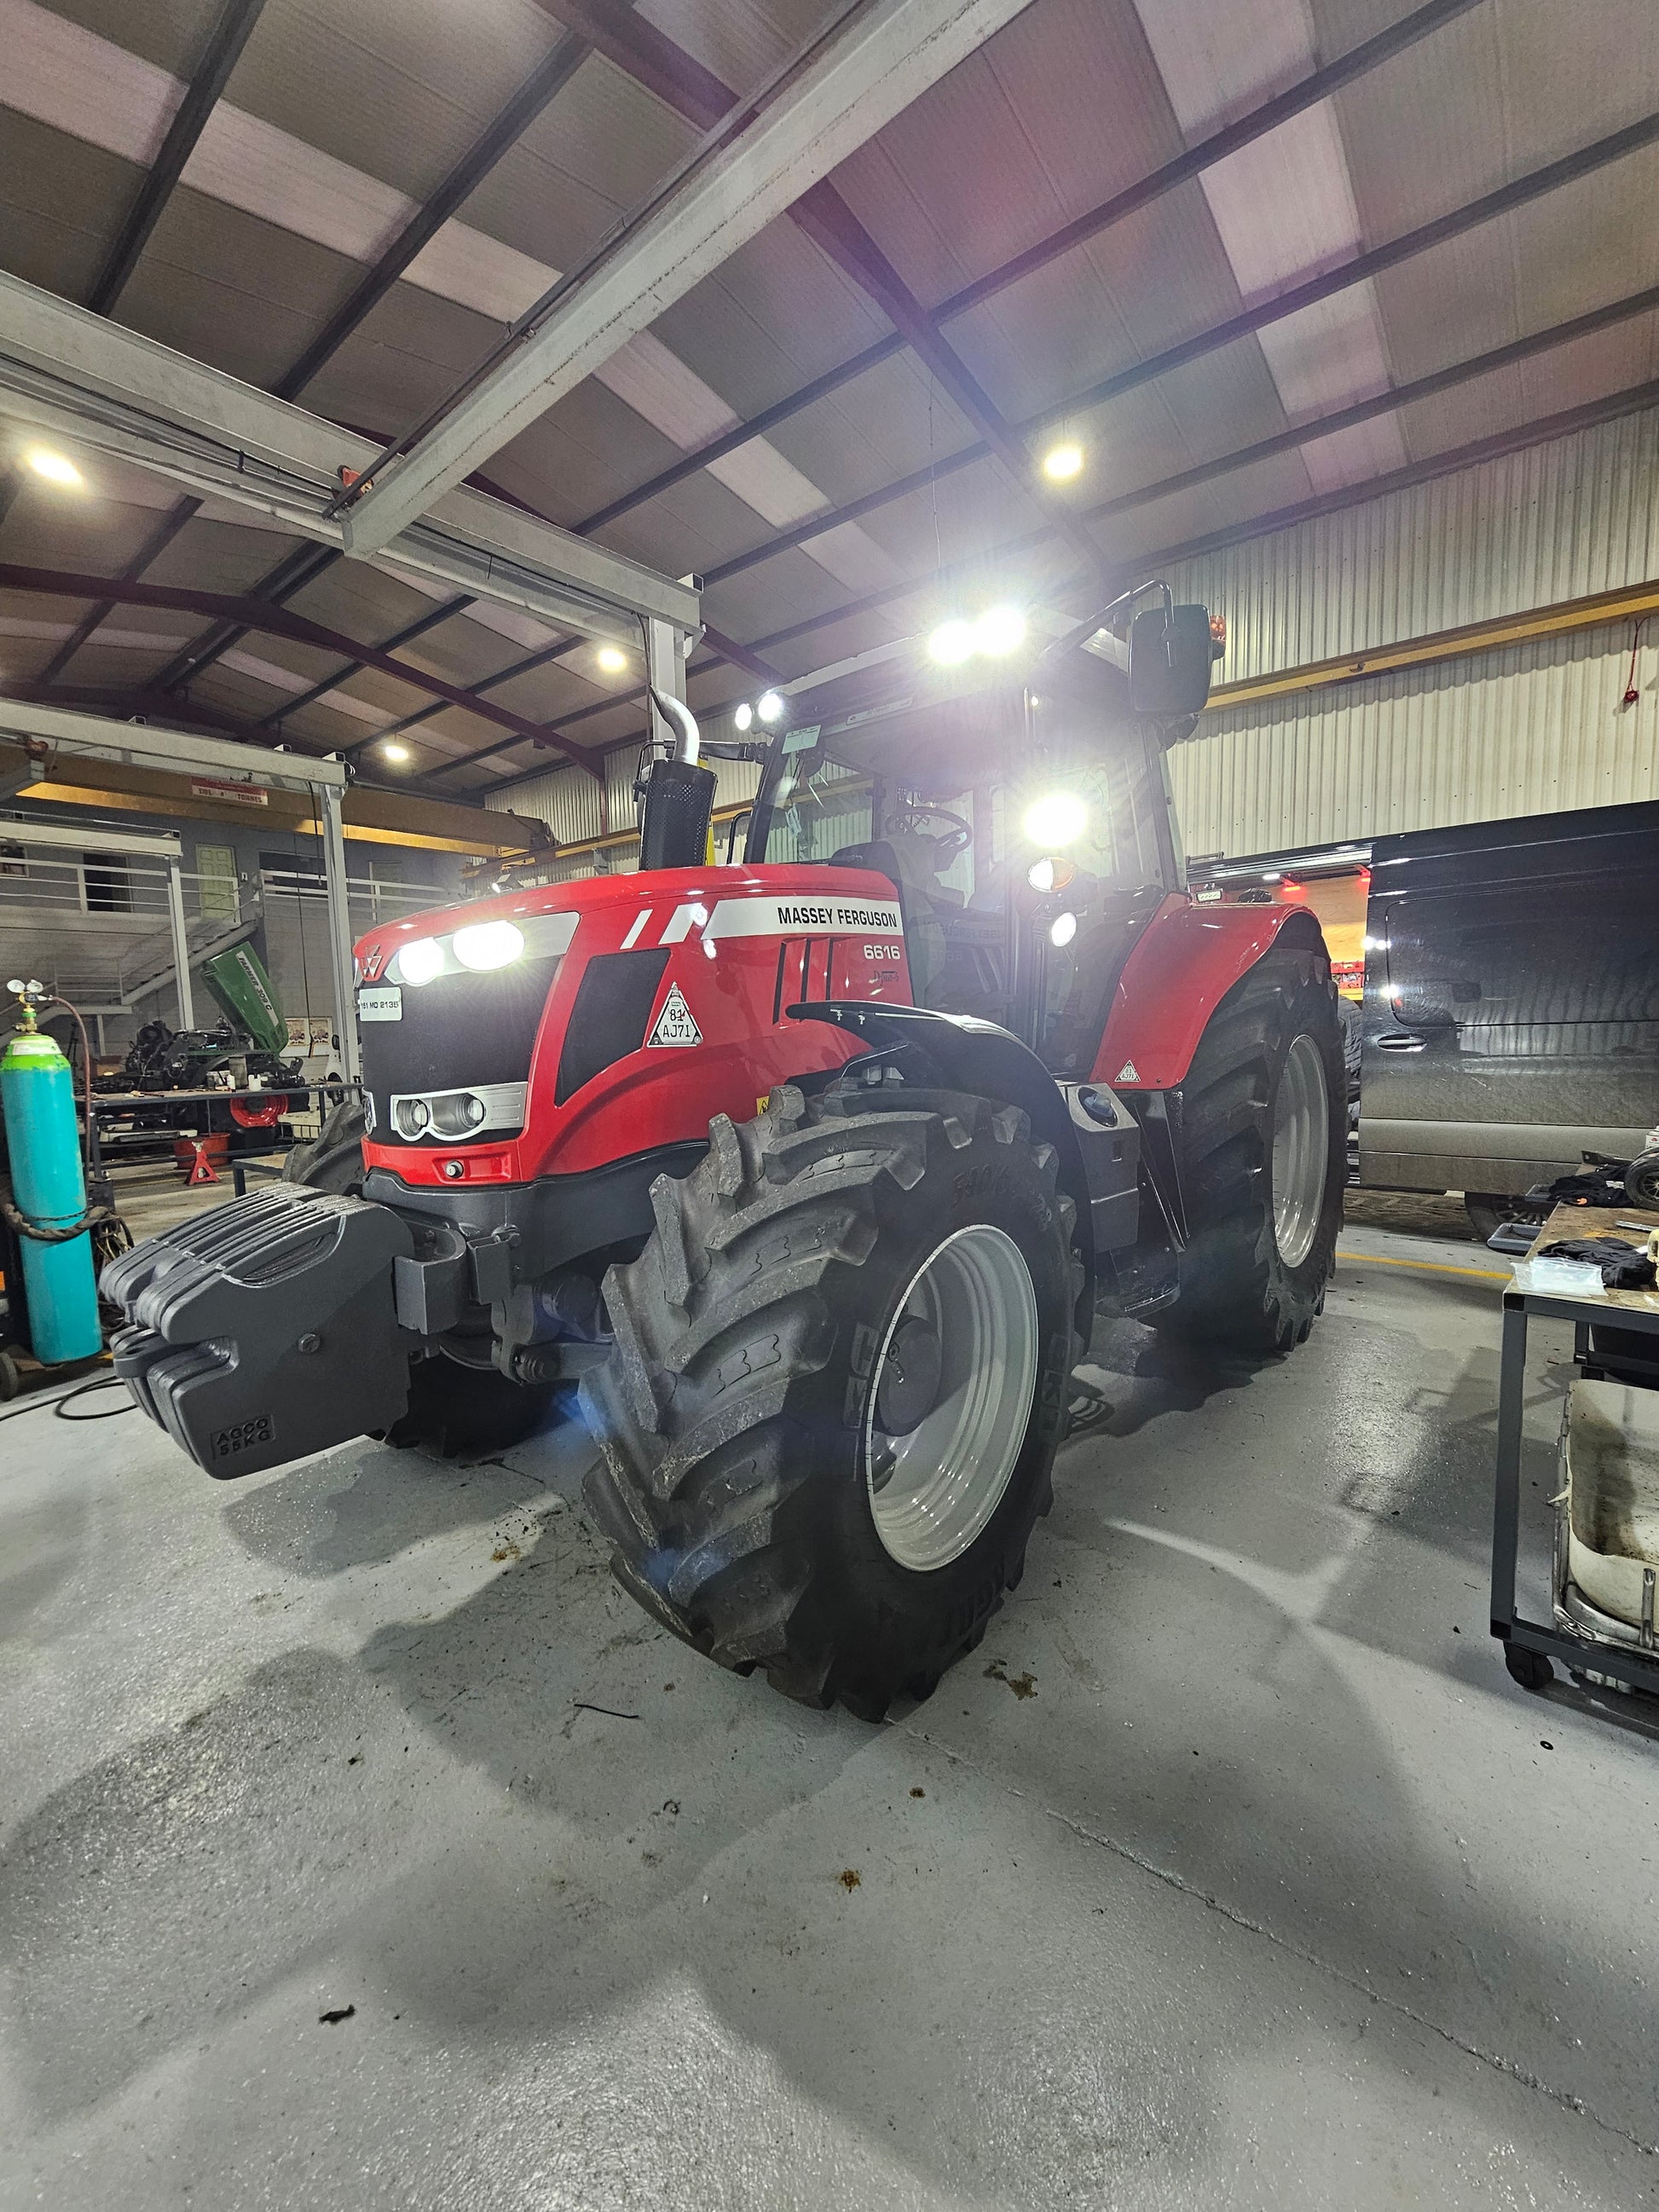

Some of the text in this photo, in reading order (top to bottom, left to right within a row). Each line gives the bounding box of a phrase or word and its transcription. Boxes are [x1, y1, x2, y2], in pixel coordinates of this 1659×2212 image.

[238, 794, 263, 803] TONNES
[777, 907, 898, 927] MASSEY FERGUSON
[864, 944, 901, 960] 6616
[239, 956, 259, 986] FARMER
[216, 1418, 269, 1446] AGCO
[220, 1429, 271, 1456] 55KG
